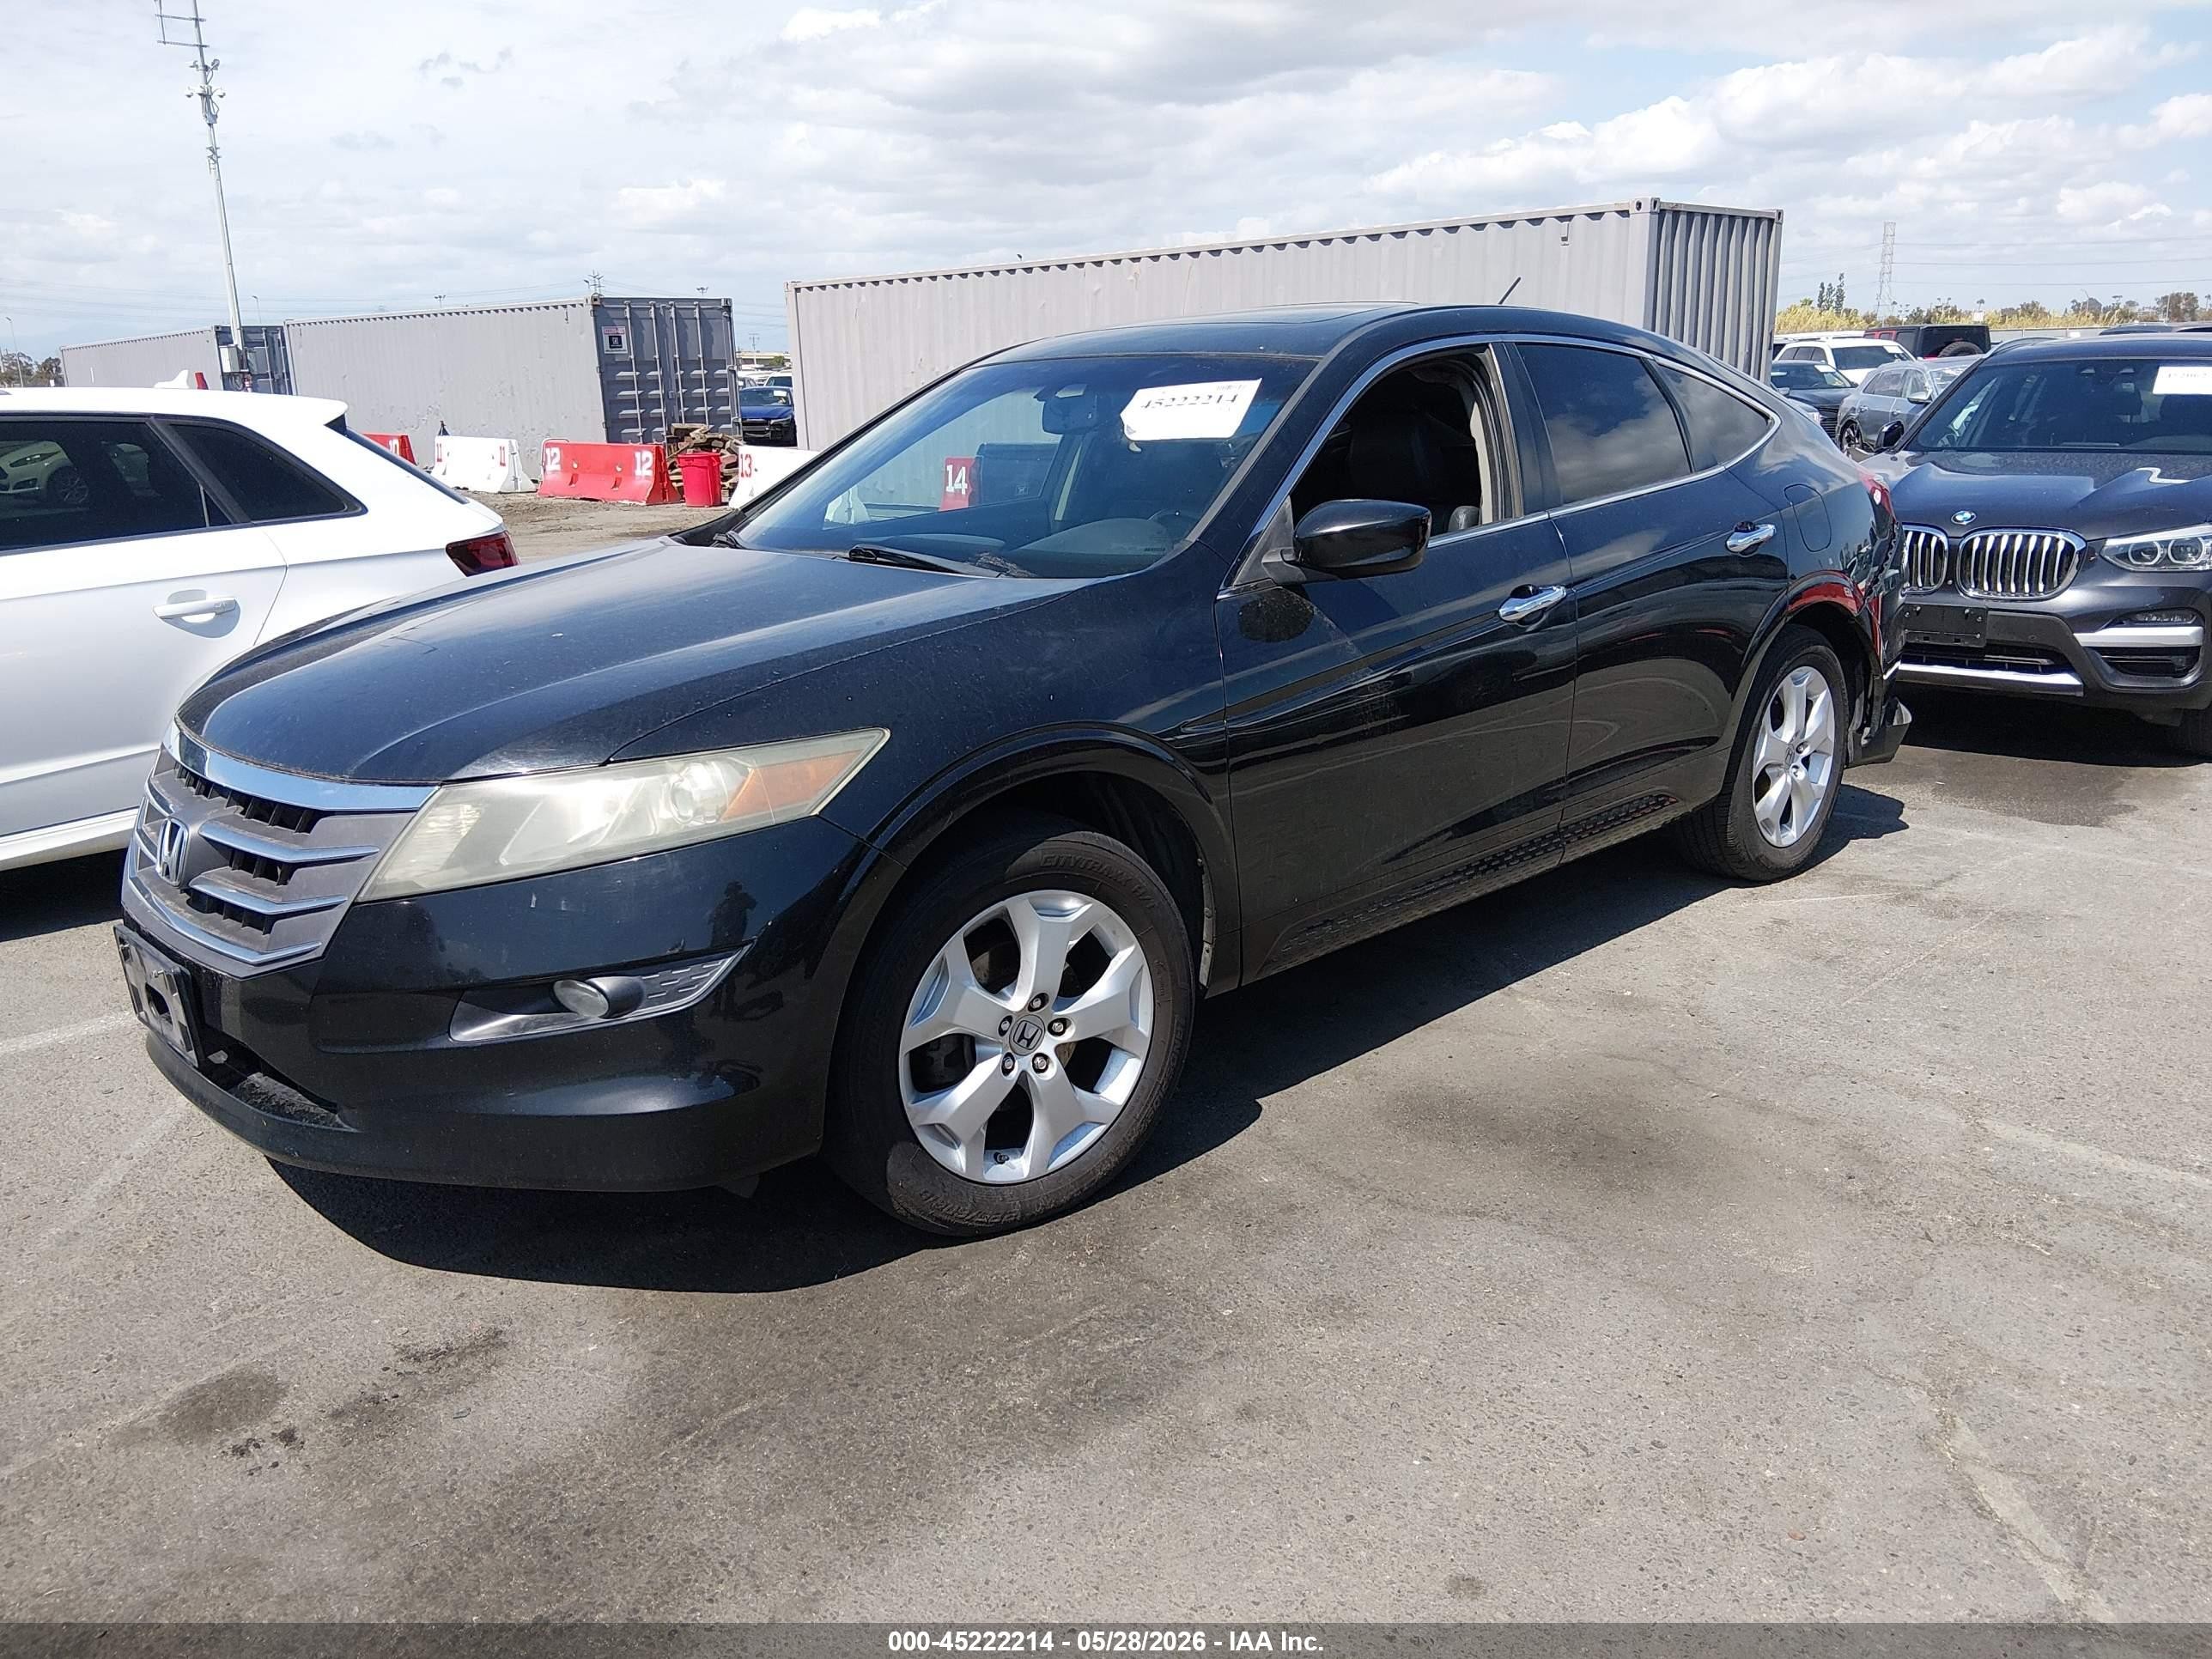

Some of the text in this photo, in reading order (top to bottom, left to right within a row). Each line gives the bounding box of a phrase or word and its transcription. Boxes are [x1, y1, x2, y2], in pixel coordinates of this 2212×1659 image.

[545, 447, 562, 471] 12
[634, 450, 653, 477] 12
[740, 453, 752, 478] 13
[945, 464, 969, 495] 14
